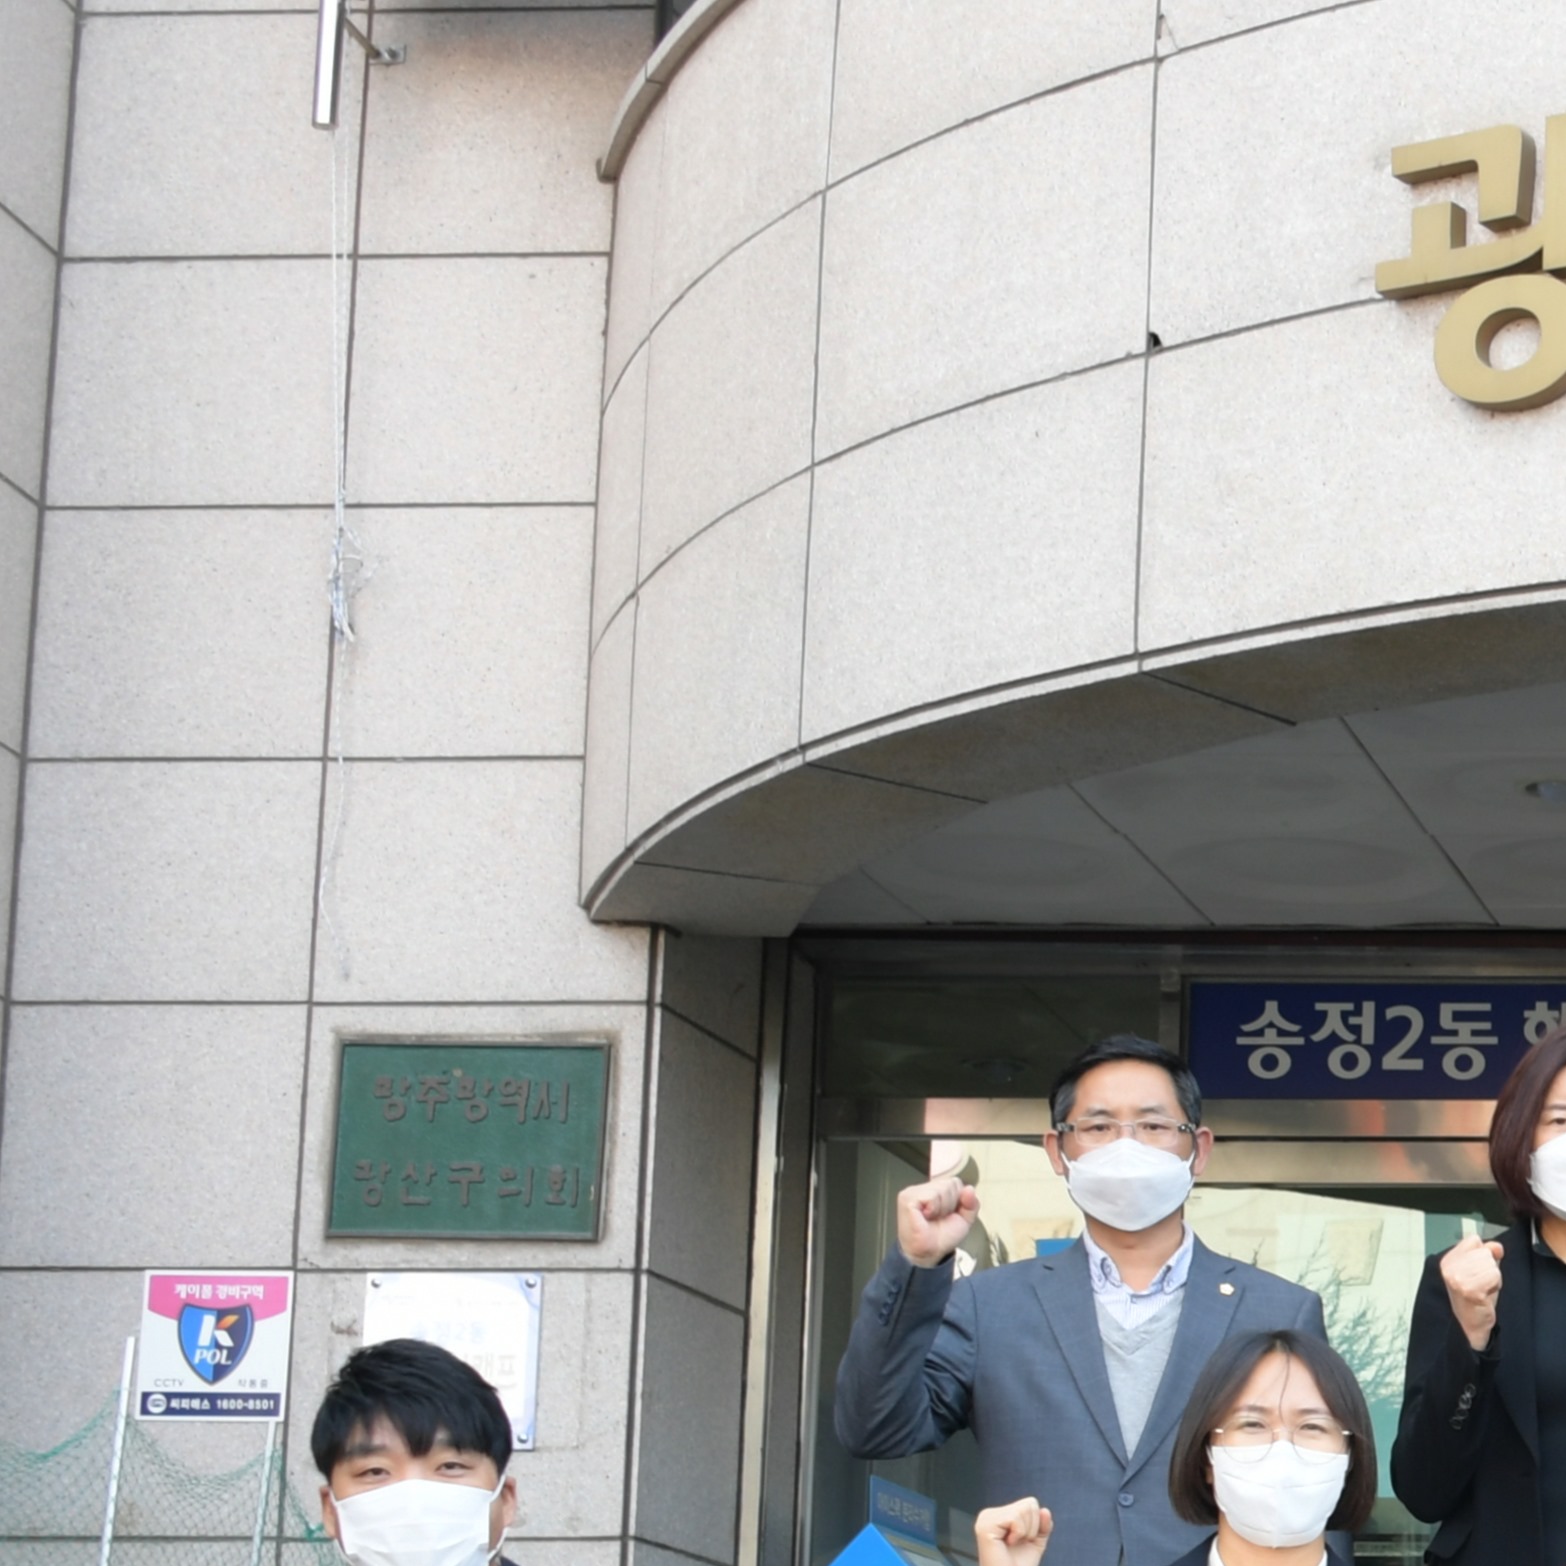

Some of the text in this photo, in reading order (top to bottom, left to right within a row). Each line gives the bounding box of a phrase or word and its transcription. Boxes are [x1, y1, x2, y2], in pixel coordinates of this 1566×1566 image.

[1235, 1000, 1500, 1080] 송정2동
[353, 1159, 580, 1208] 광산구의회
[193, 1348, 233, 1366] POL
[153, 1378, 185, 1388] CCTV
